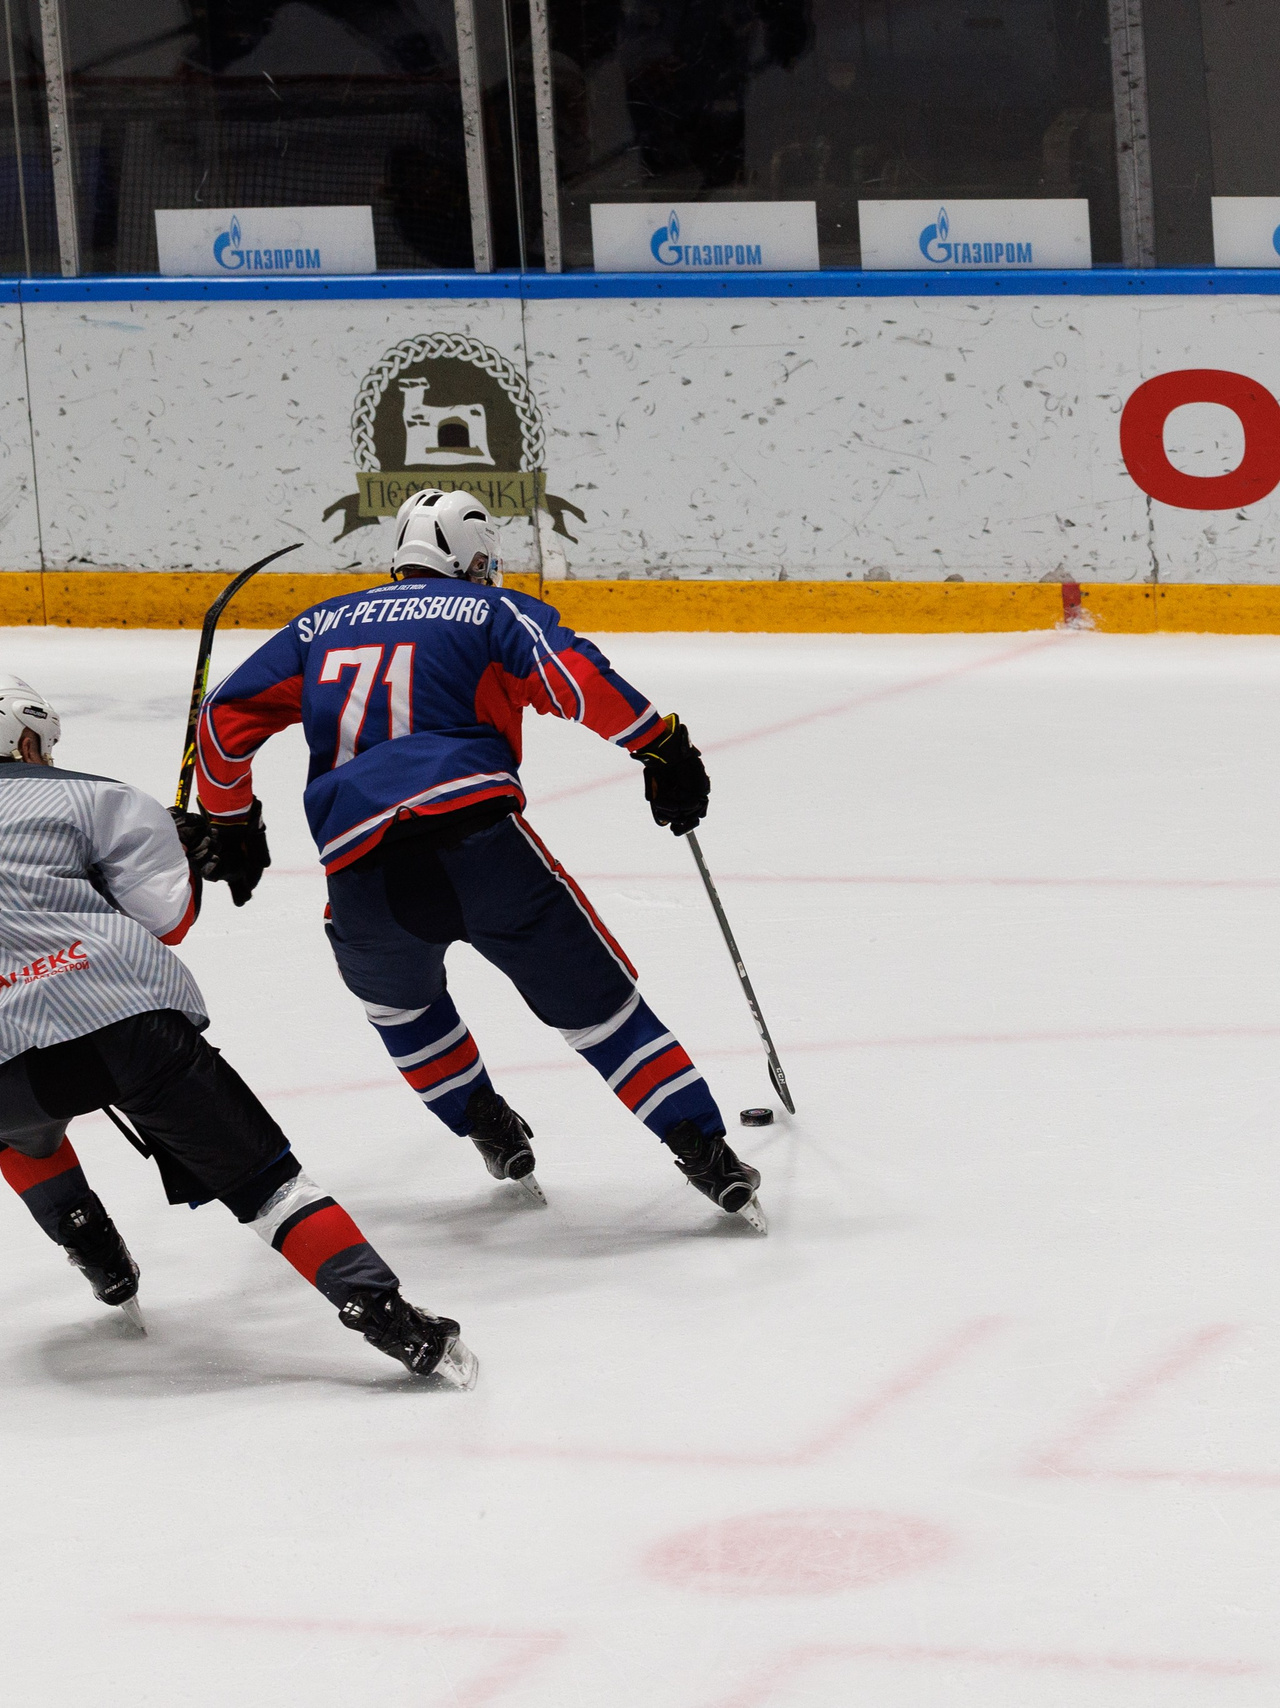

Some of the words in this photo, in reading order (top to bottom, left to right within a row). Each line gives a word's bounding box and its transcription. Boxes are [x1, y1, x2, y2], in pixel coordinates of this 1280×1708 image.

[245, 249, 321, 270] ГАЗПРОМ
[684, 244, 762, 266] ГАЗПРОМ
[952, 242, 1033, 264] ГАЗПРОМ
[320, 643, 415, 768] 71
